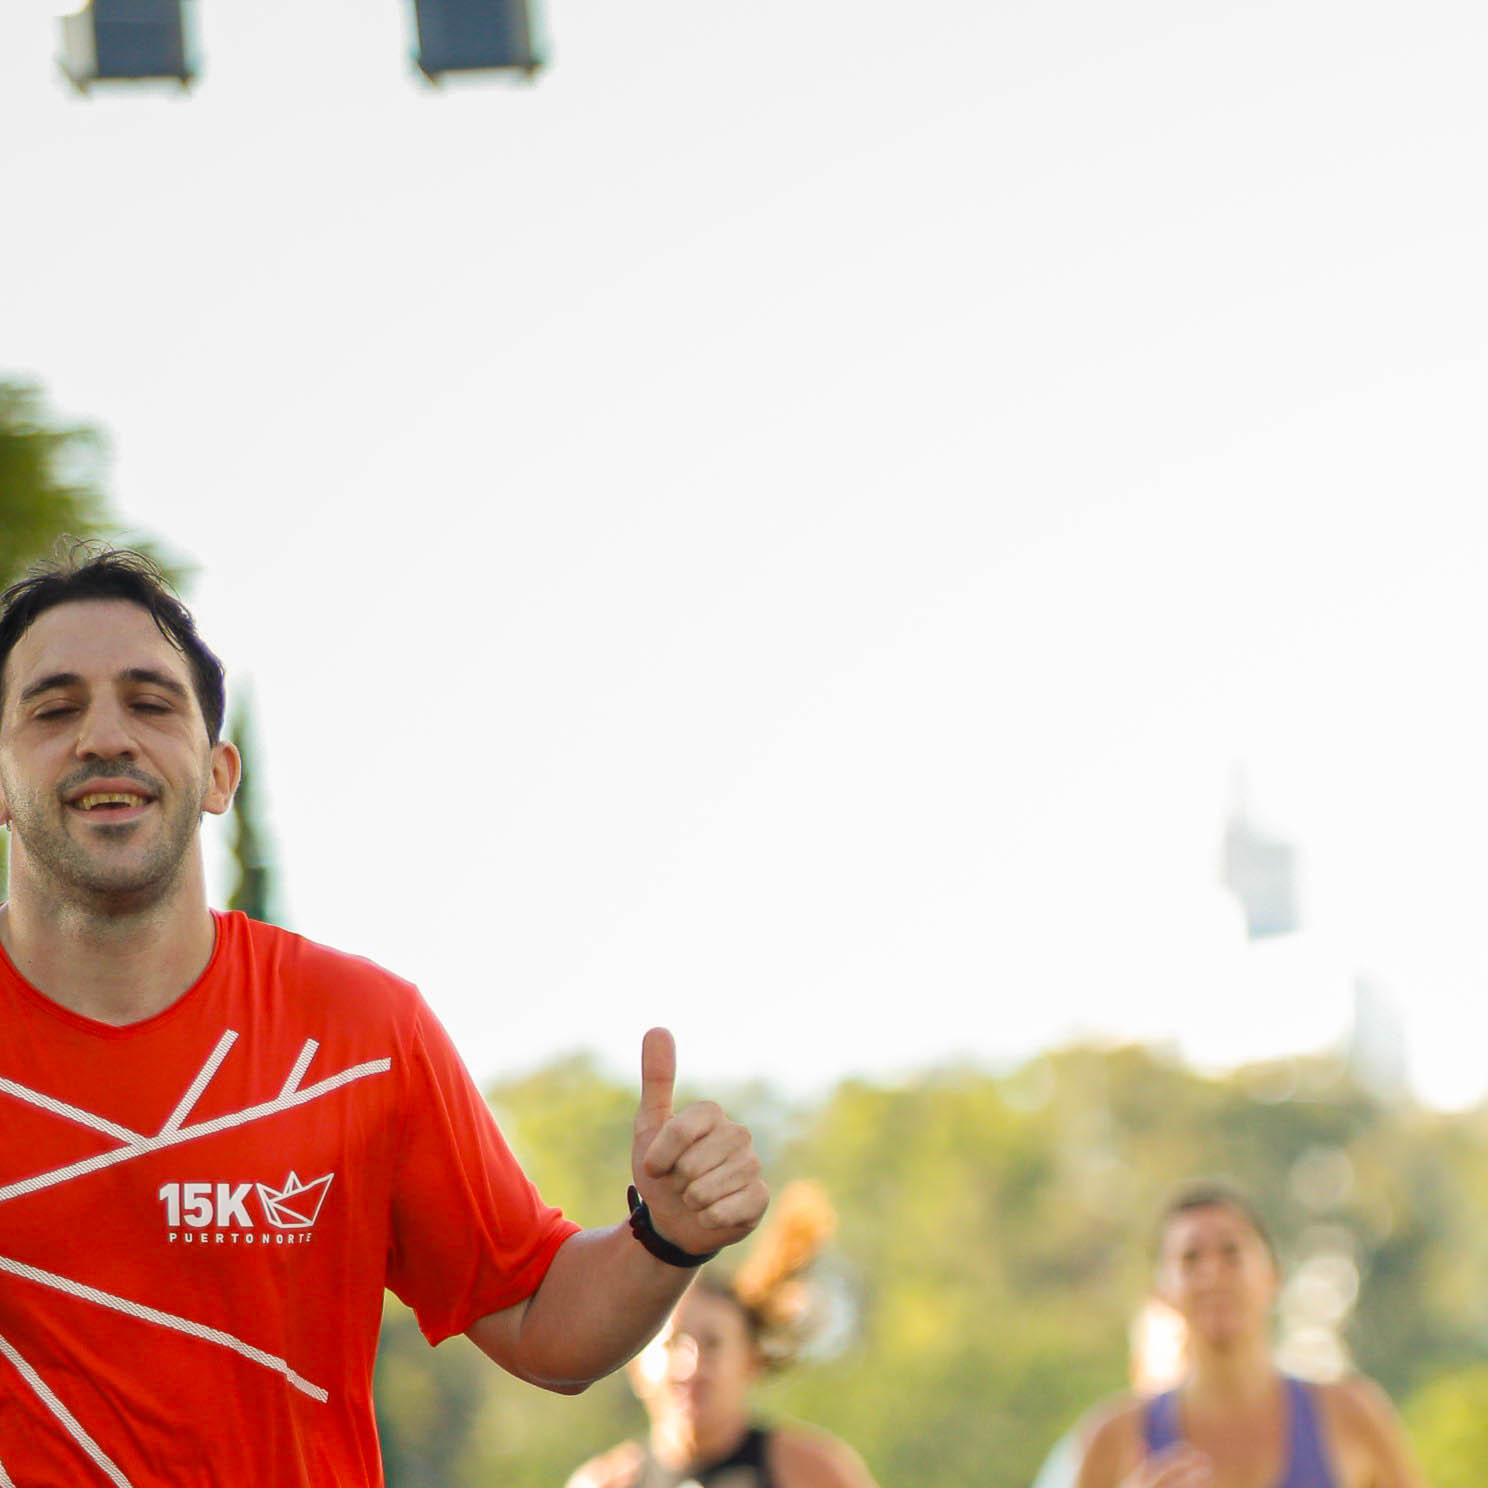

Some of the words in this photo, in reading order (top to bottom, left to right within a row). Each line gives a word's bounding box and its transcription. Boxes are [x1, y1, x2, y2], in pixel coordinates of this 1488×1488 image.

[159, 1183, 254, 1228] 15K
[168, 1233, 254, 1243] PUERTO
[262, 1232, 313, 1244] NORTE
